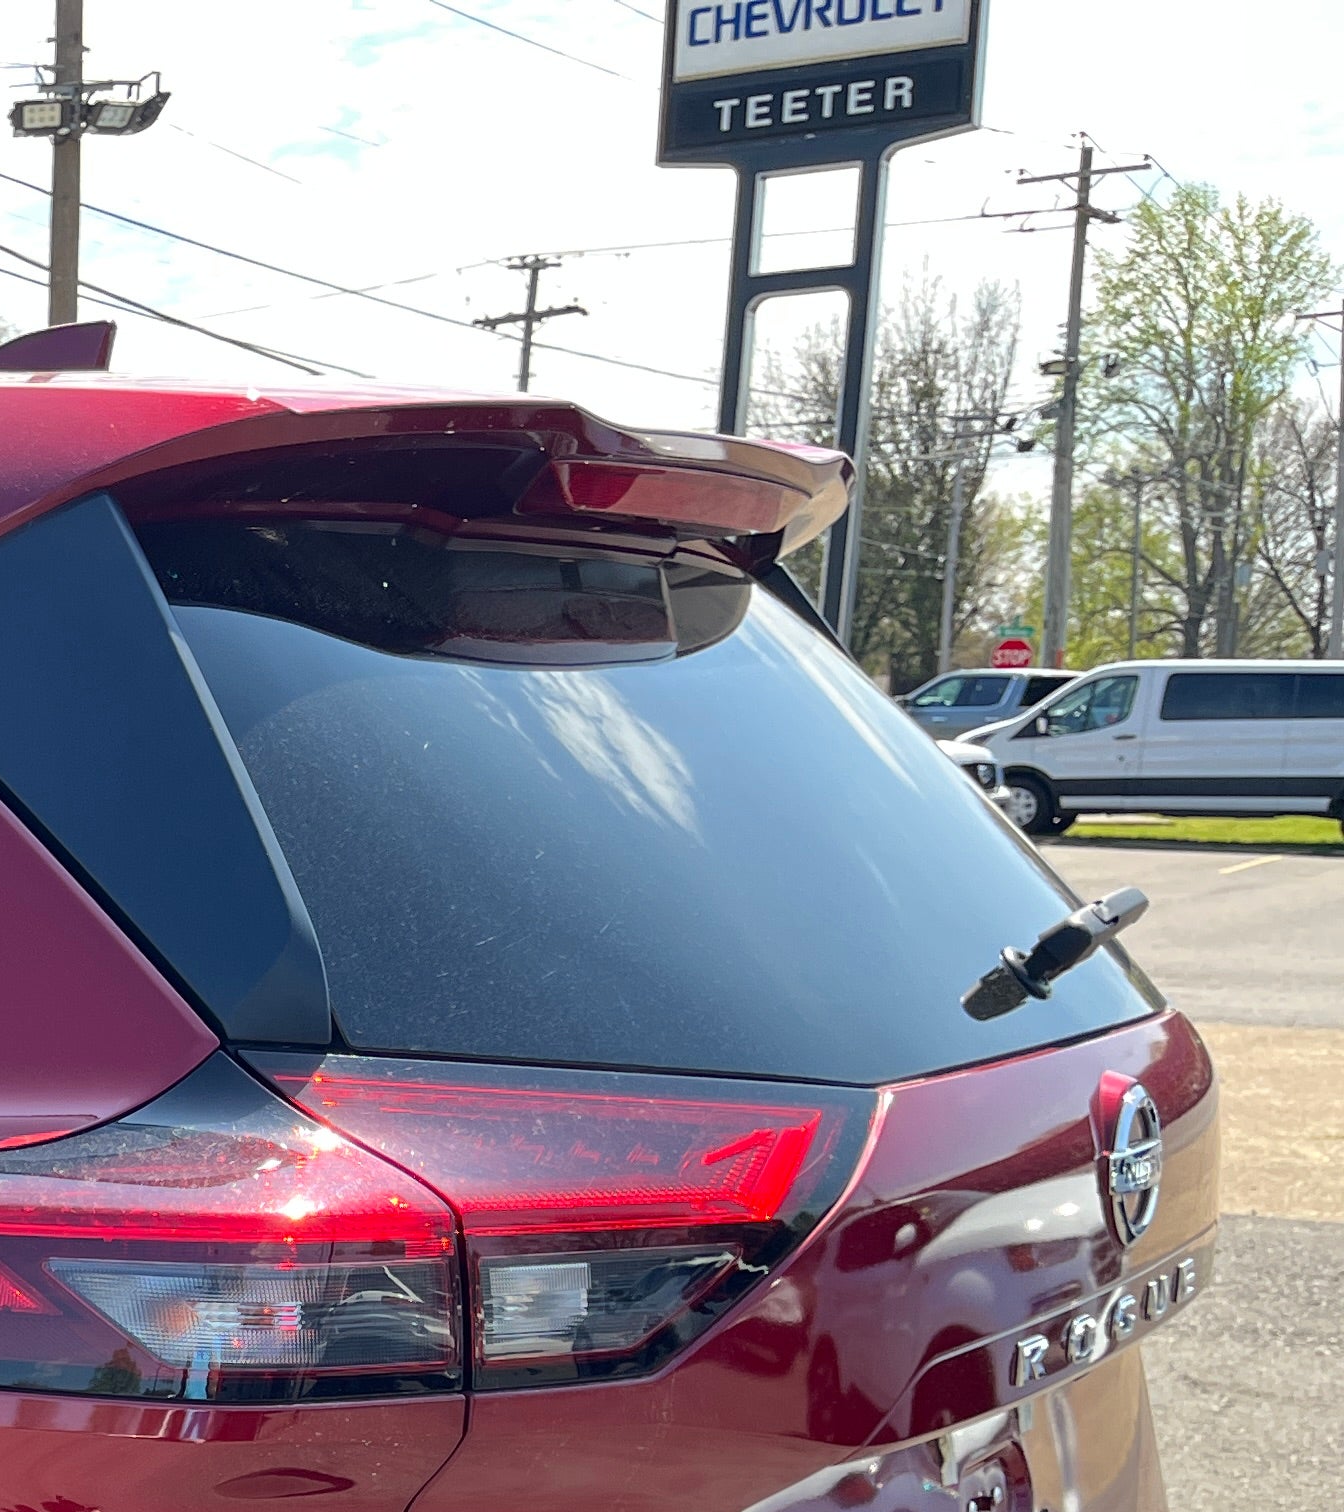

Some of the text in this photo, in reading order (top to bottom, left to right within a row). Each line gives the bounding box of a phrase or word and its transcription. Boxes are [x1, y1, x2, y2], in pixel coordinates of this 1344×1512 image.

[713, 75, 914, 132] TEETER
[991, 648, 1032, 666] STOP
[1010, 1257, 1196, 1387] ROGUE
